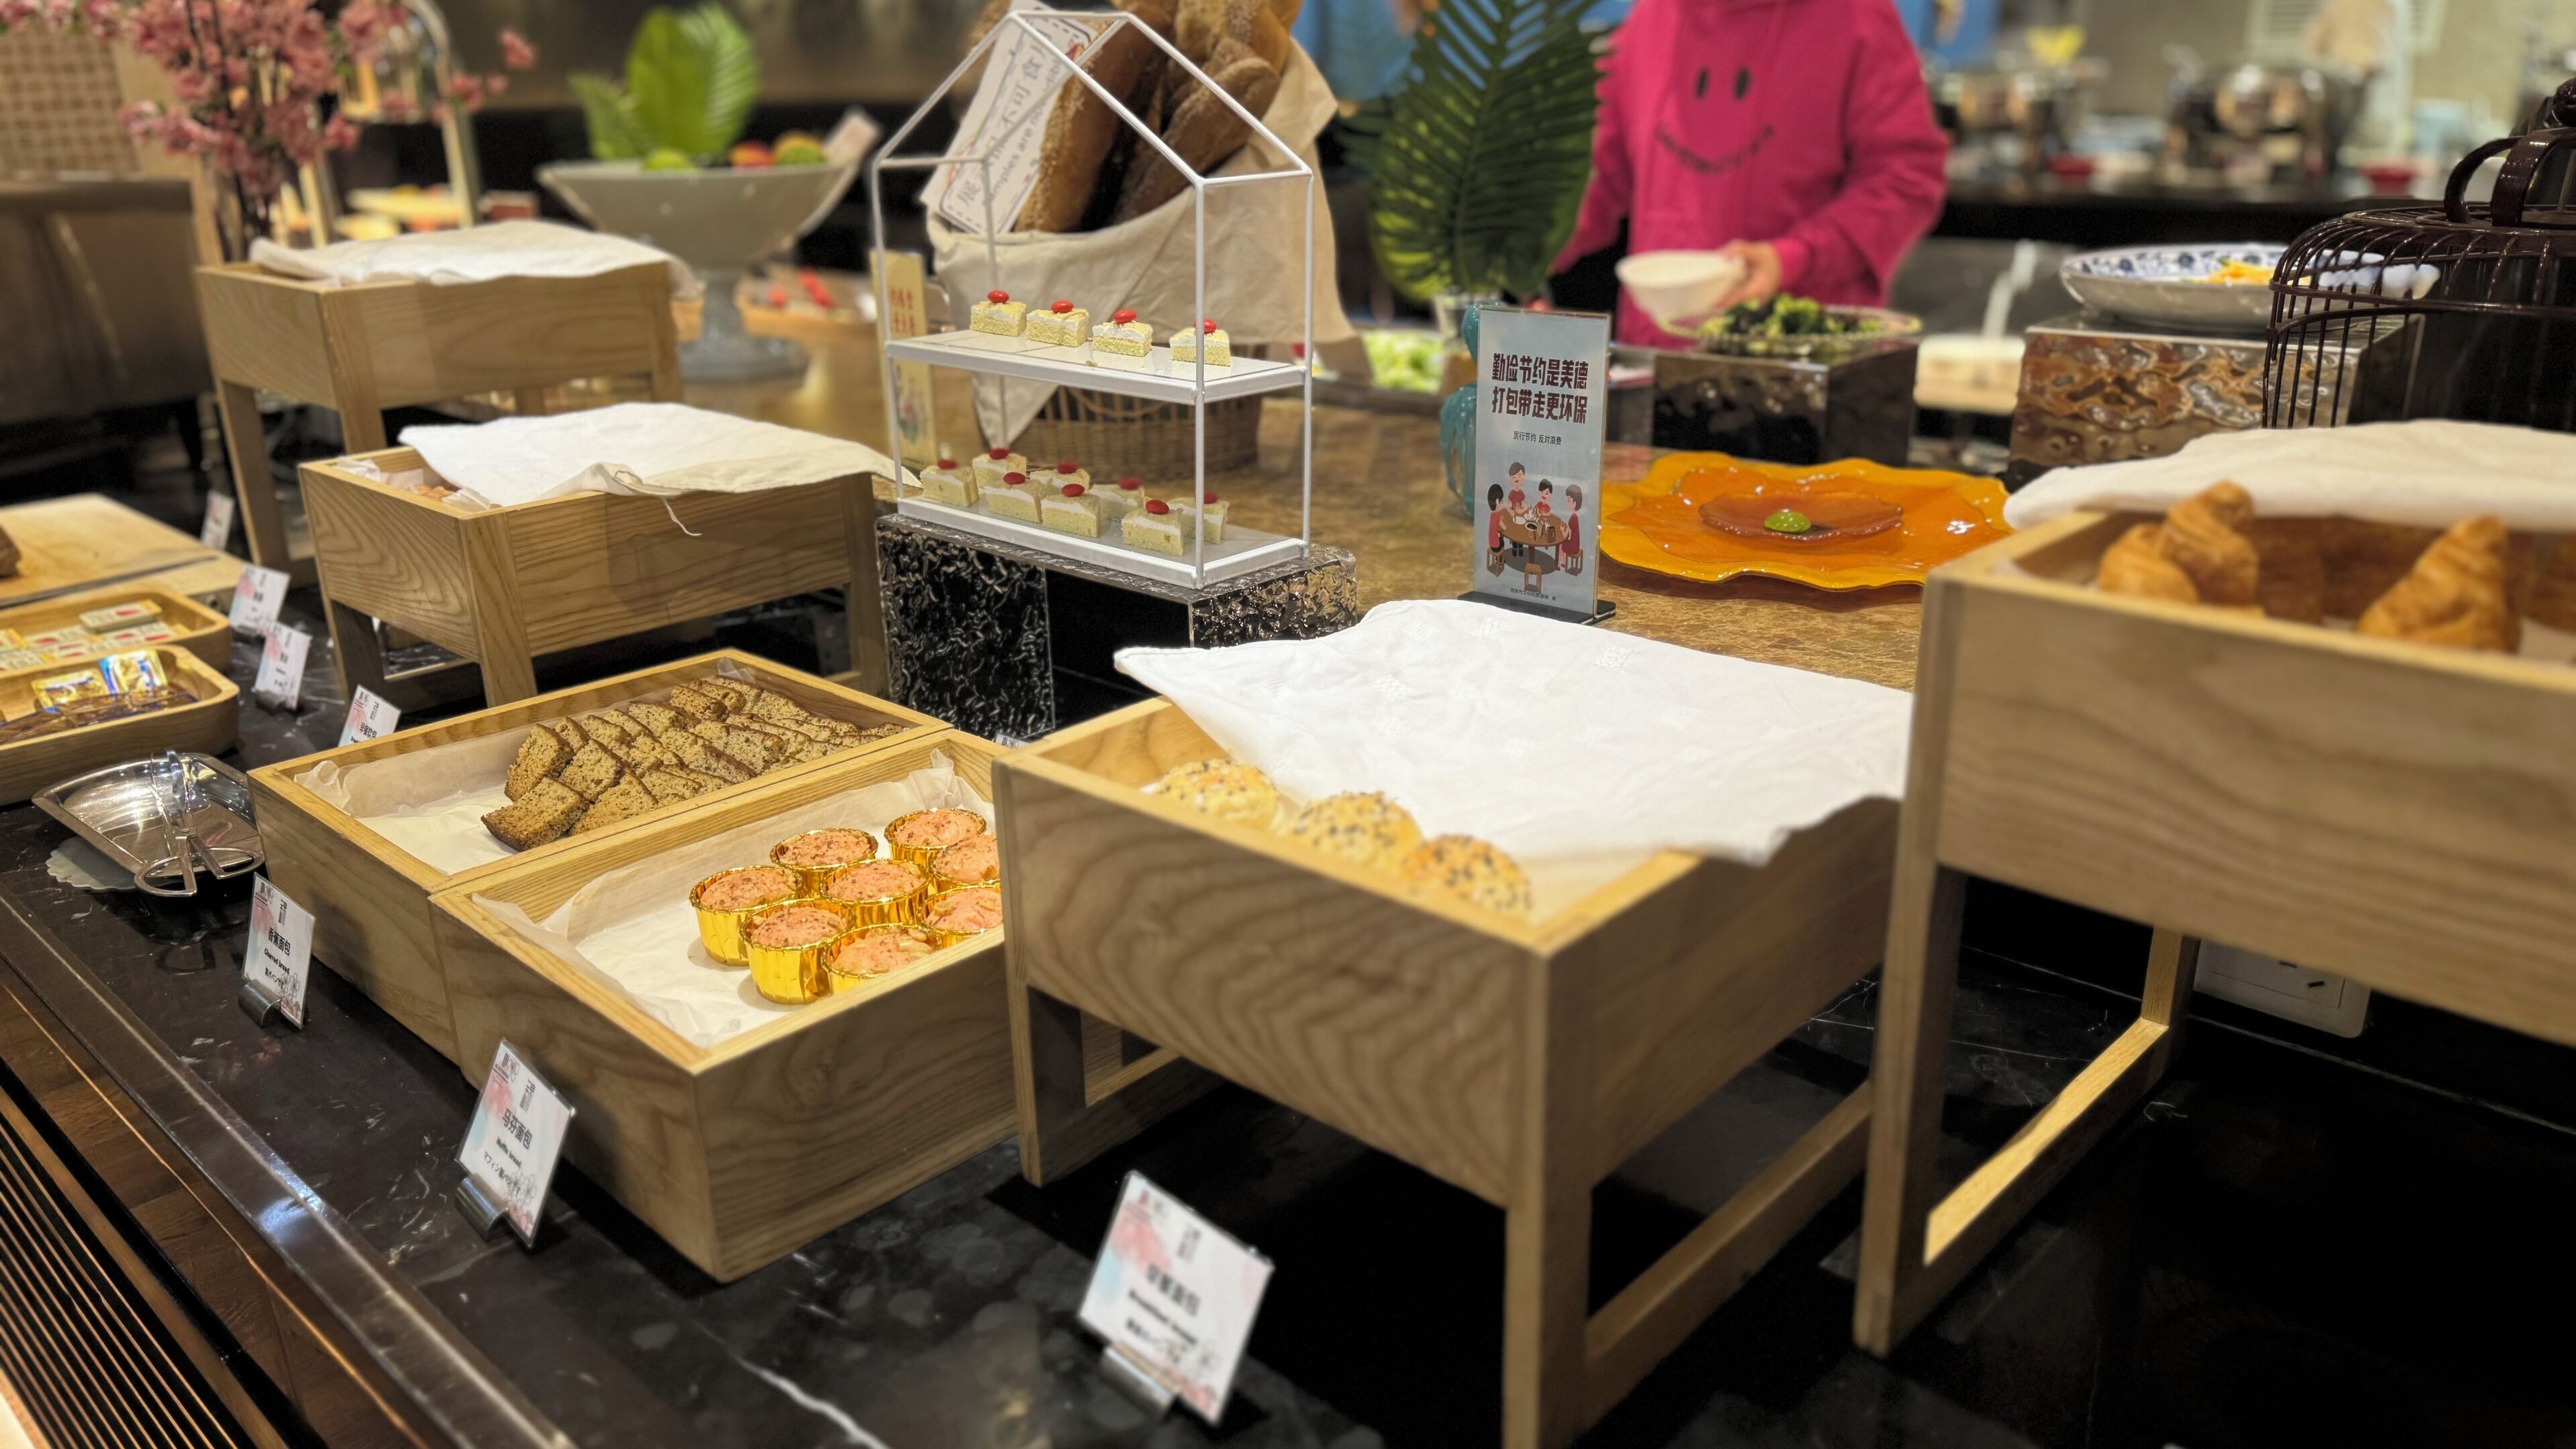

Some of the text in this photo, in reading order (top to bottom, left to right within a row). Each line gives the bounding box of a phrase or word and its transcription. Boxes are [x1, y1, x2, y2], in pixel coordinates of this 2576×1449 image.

[1491, 352, 1589, 390] 勤俭节约是美德
[1491, 386, 1588, 424] 打包带走更环保
[1513, 431, 1562, 445] 厉行节约 反对浪费
[268, 926, 290, 956] 香蕉面包
[278, 960, 290, 975] bread
[502, 1108, 533, 1150] 马芬面包
[508, 1150, 522, 1168] bread
